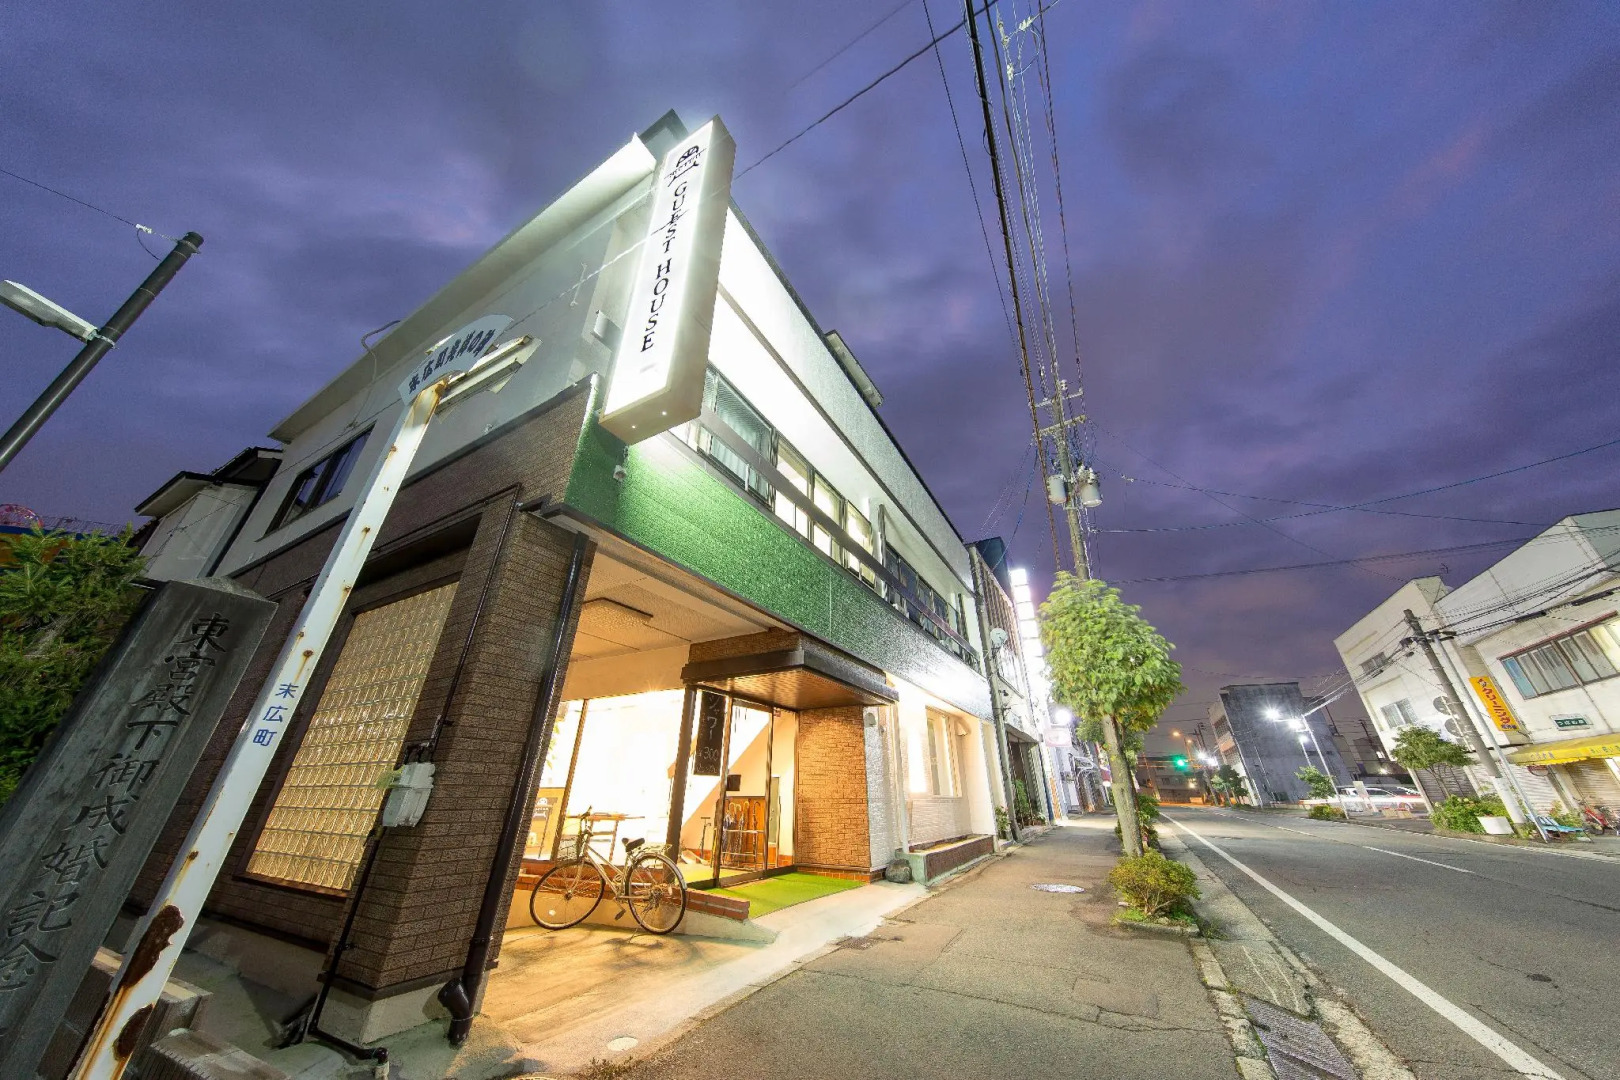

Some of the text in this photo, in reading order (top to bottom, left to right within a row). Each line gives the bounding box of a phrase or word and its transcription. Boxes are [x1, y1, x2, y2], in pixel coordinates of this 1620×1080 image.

[640, 181, 688, 353] GUEST HOUSE
[251, 682, 300, 749] 末広町
